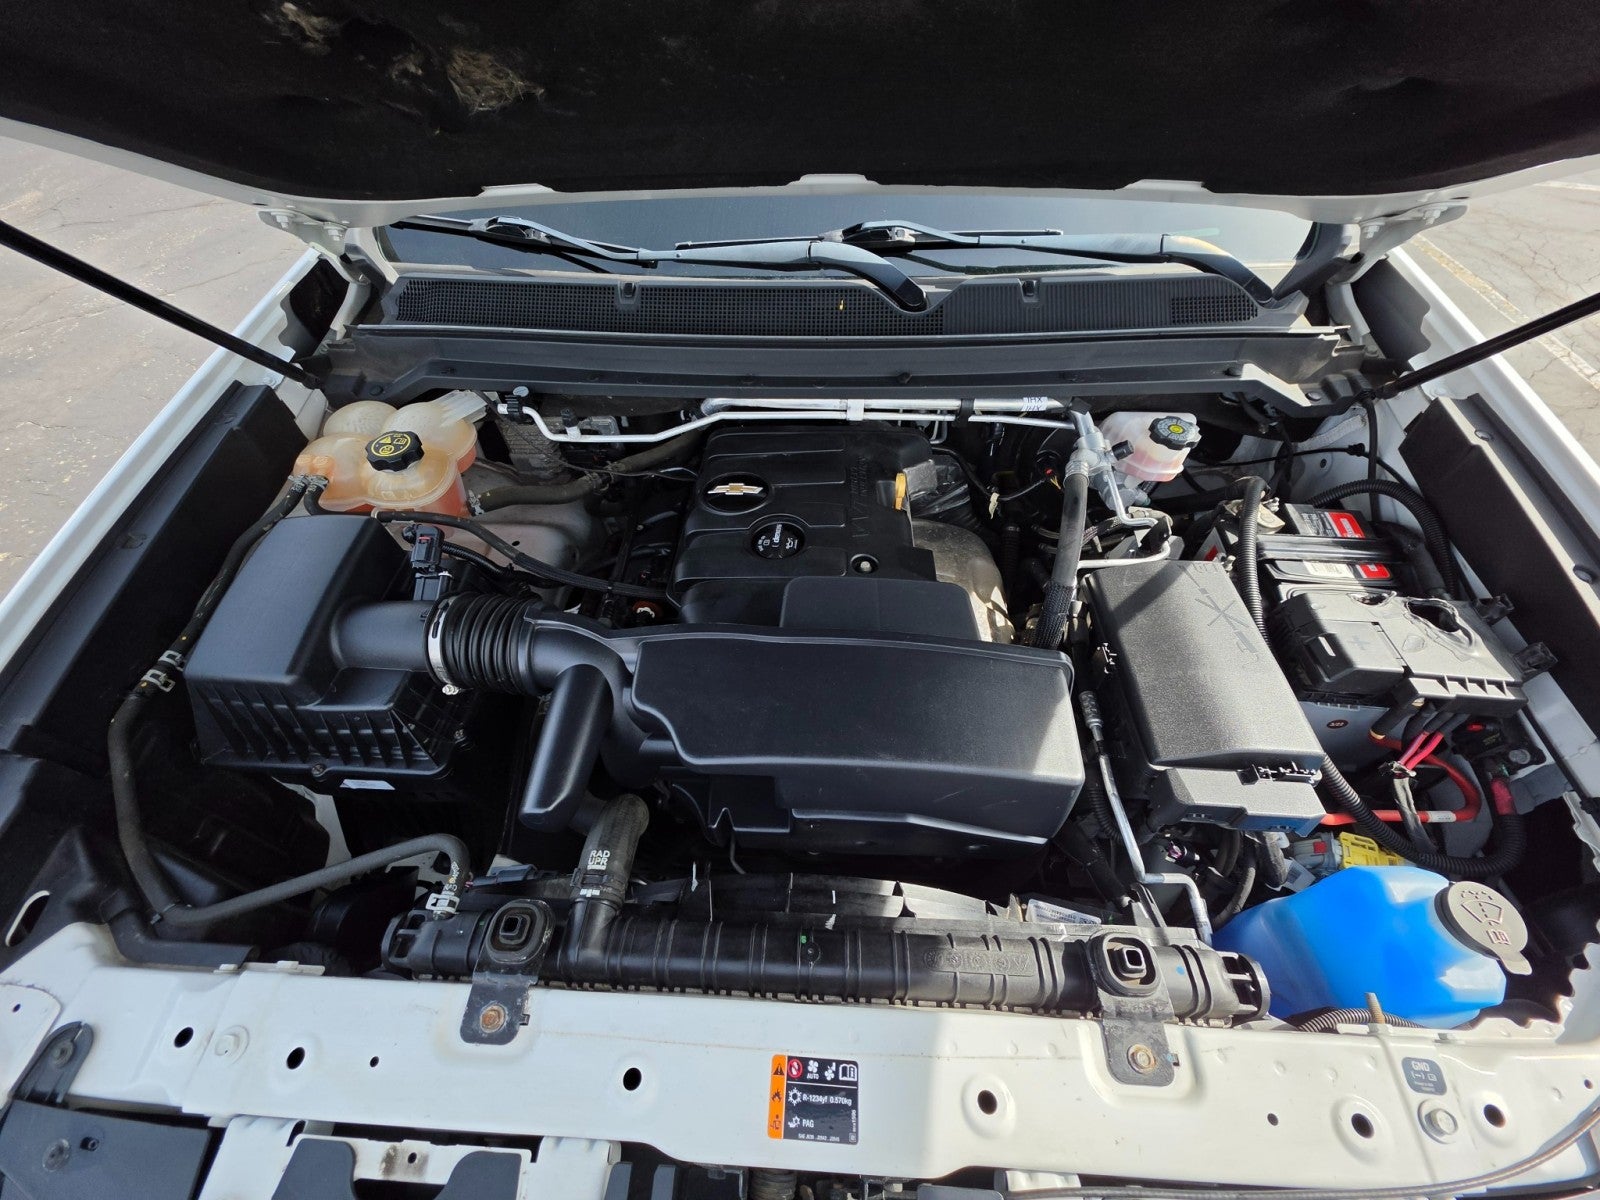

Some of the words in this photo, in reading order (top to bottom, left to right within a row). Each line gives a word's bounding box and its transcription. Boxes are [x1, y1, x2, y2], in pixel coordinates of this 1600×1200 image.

[590, 850, 610, 858] RAD
[588, 857, 608, 865] UPR
[802, 1093, 828, 1105] R-1234yf
[829, 1096, 852, 1107] 0.570kg
[802, 1119, 814, 1128] PAG
